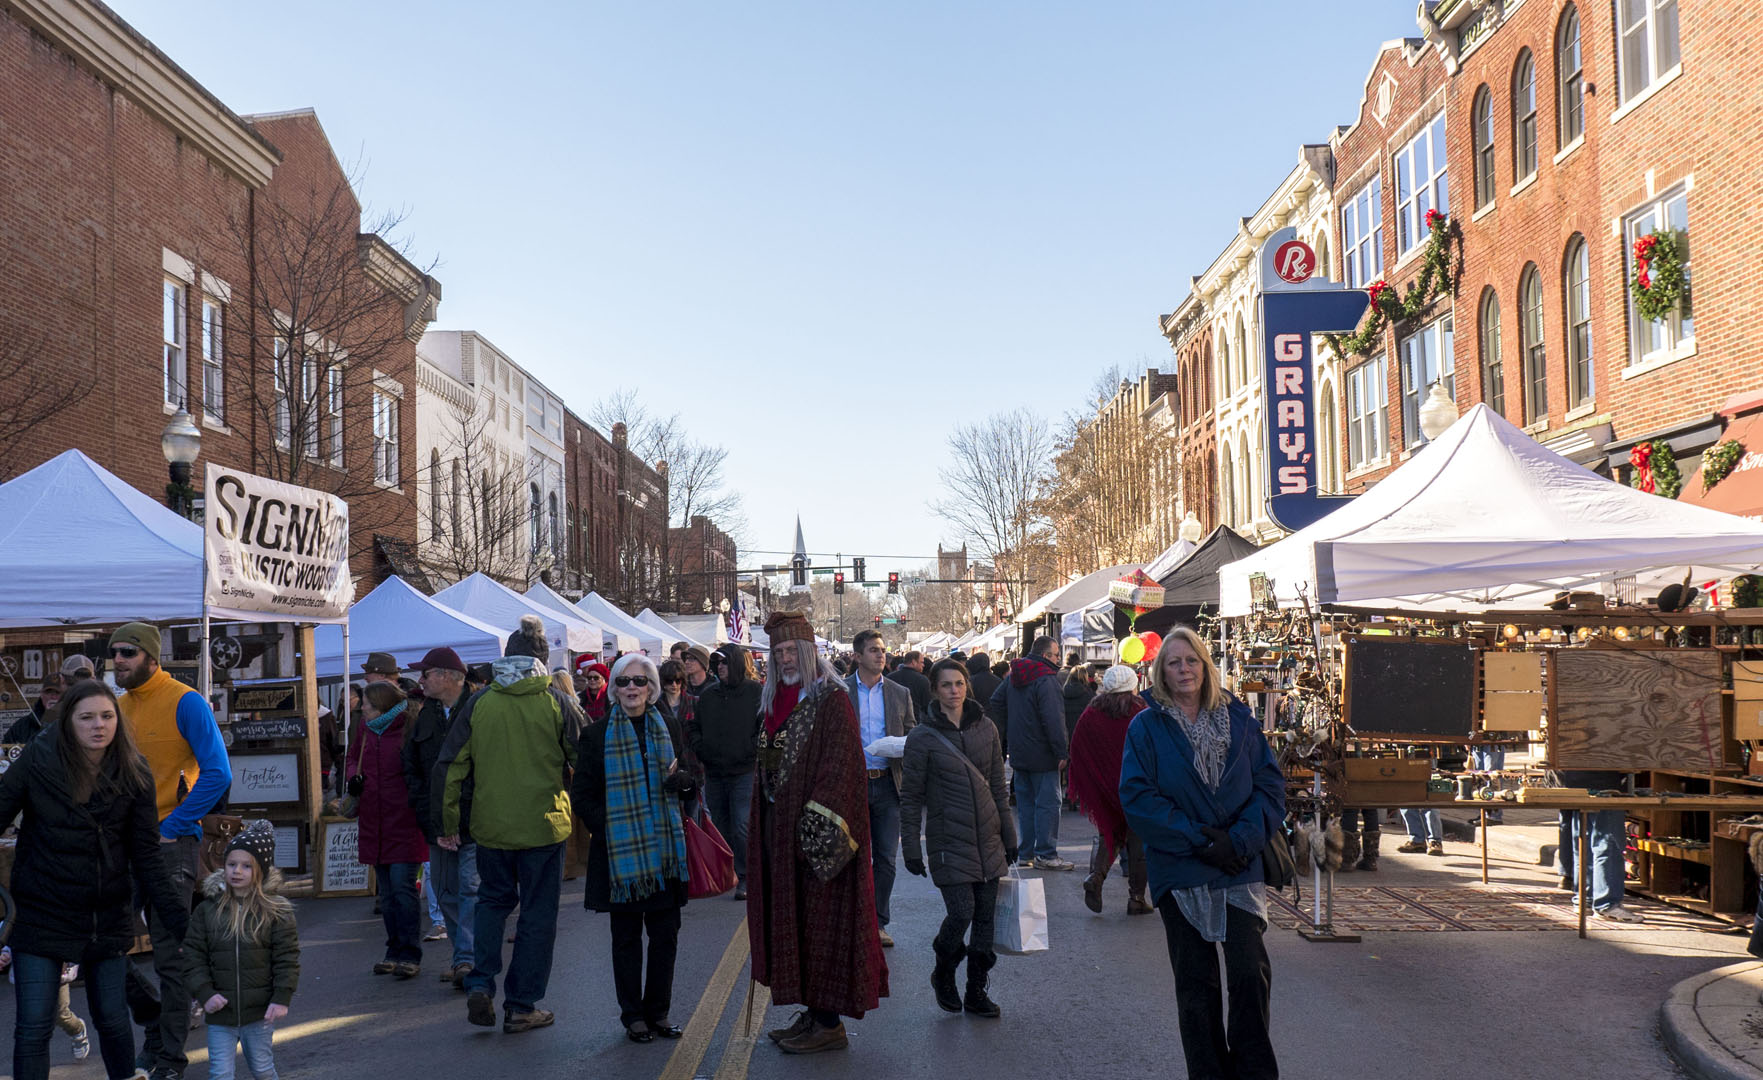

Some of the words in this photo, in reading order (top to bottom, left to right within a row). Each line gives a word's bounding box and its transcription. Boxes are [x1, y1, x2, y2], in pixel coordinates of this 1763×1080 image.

[1274, 333, 1312, 495] GRAY'S
[241, 551, 295, 588] RUSTIC
[240, 766, 287, 790] together
